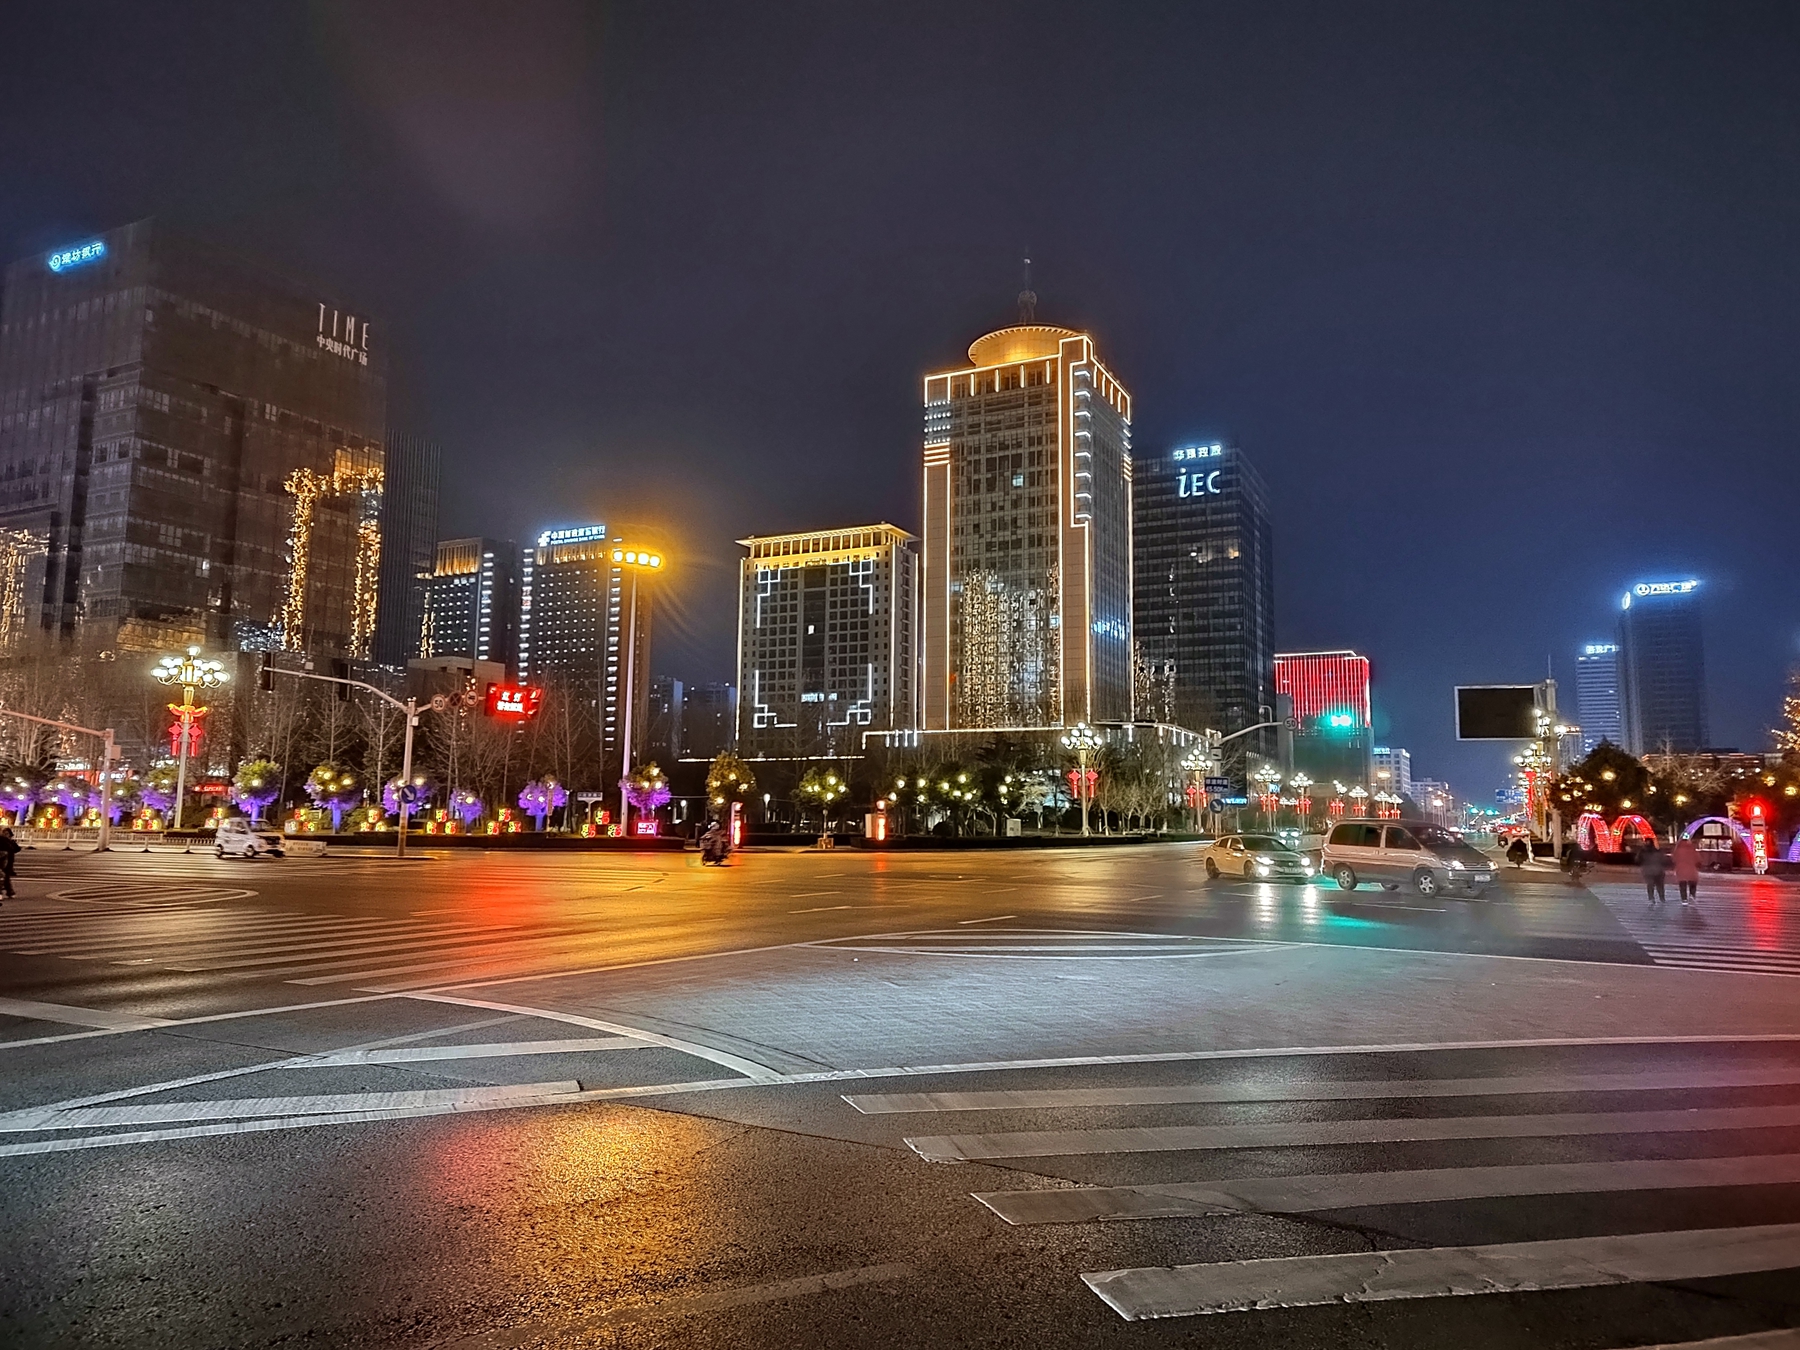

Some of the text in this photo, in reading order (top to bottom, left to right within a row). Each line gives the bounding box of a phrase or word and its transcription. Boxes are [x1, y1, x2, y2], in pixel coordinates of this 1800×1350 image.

[319, 303, 369, 351] TIME
[316, 334, 368, 366] 中央时代广场
[1286, 720, 1296, 728] 50
